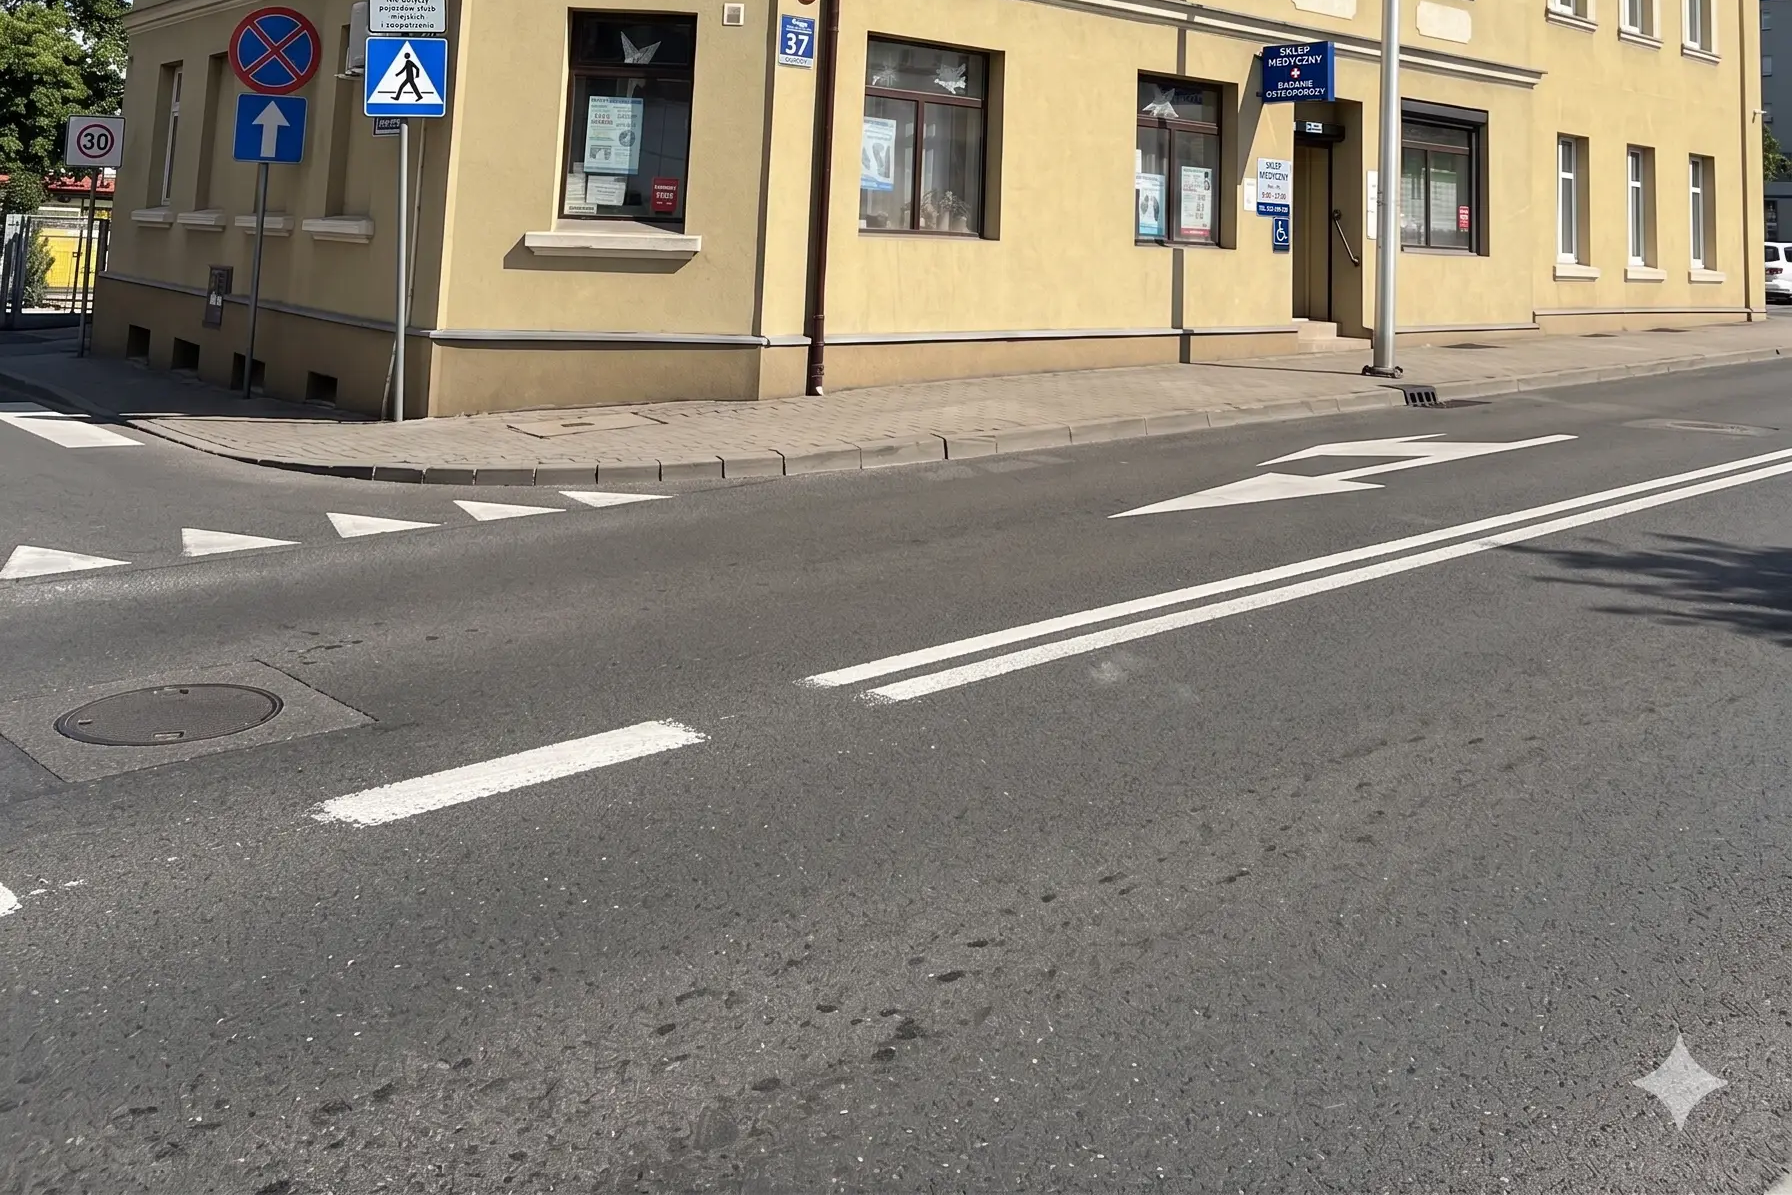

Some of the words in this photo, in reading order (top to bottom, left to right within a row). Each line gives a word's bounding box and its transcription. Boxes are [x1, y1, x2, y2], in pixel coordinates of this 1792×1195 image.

[390, 13, 425, 21] miejskich
[785, 32, 809, 55] 37
[1280, 46, 1310, 56] SKLEP
[1268, 56, 1322, 67] MEDYCZNY
[1278, 80, 1313, 89] BADANIE
[1266, 88, 1325, 97] OSTEOPOROZY
[82, 132, 109, 151] 30
[1265, 162, 1281, 170] SKLEP
[1259, 171, 1288, 181] MEDYCZNY
